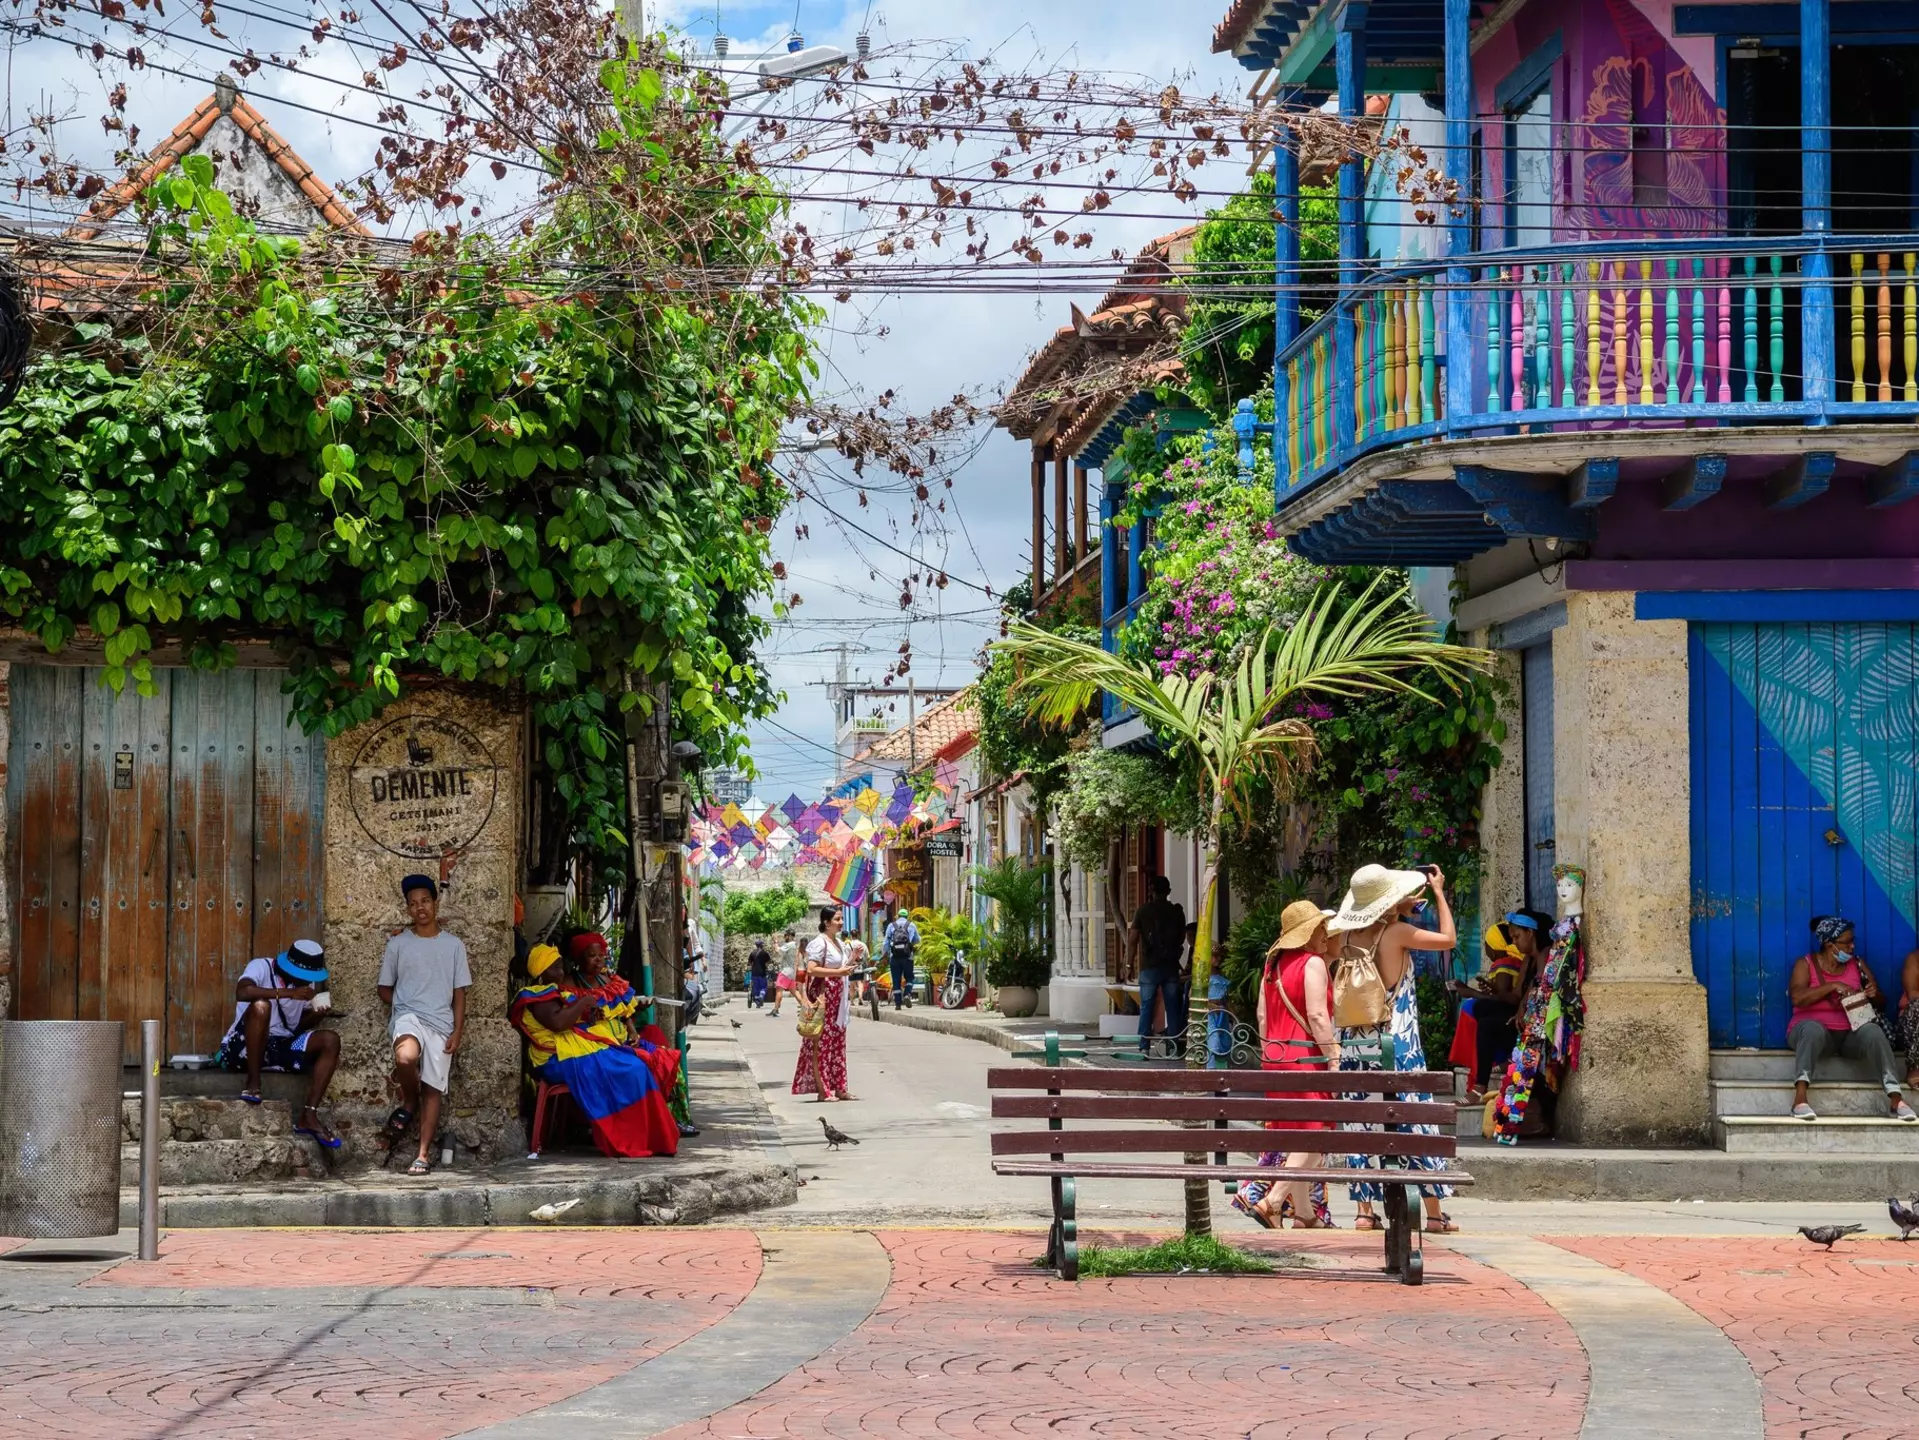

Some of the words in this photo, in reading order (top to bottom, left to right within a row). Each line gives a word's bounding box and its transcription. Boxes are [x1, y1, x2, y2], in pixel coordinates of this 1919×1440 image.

[362, 736, 388, 764] PLAZA
[391, 725, 406, 737] DE
[371, 769, 471, 803] DEMENTE
[926, 841, 947, 849] DORA
